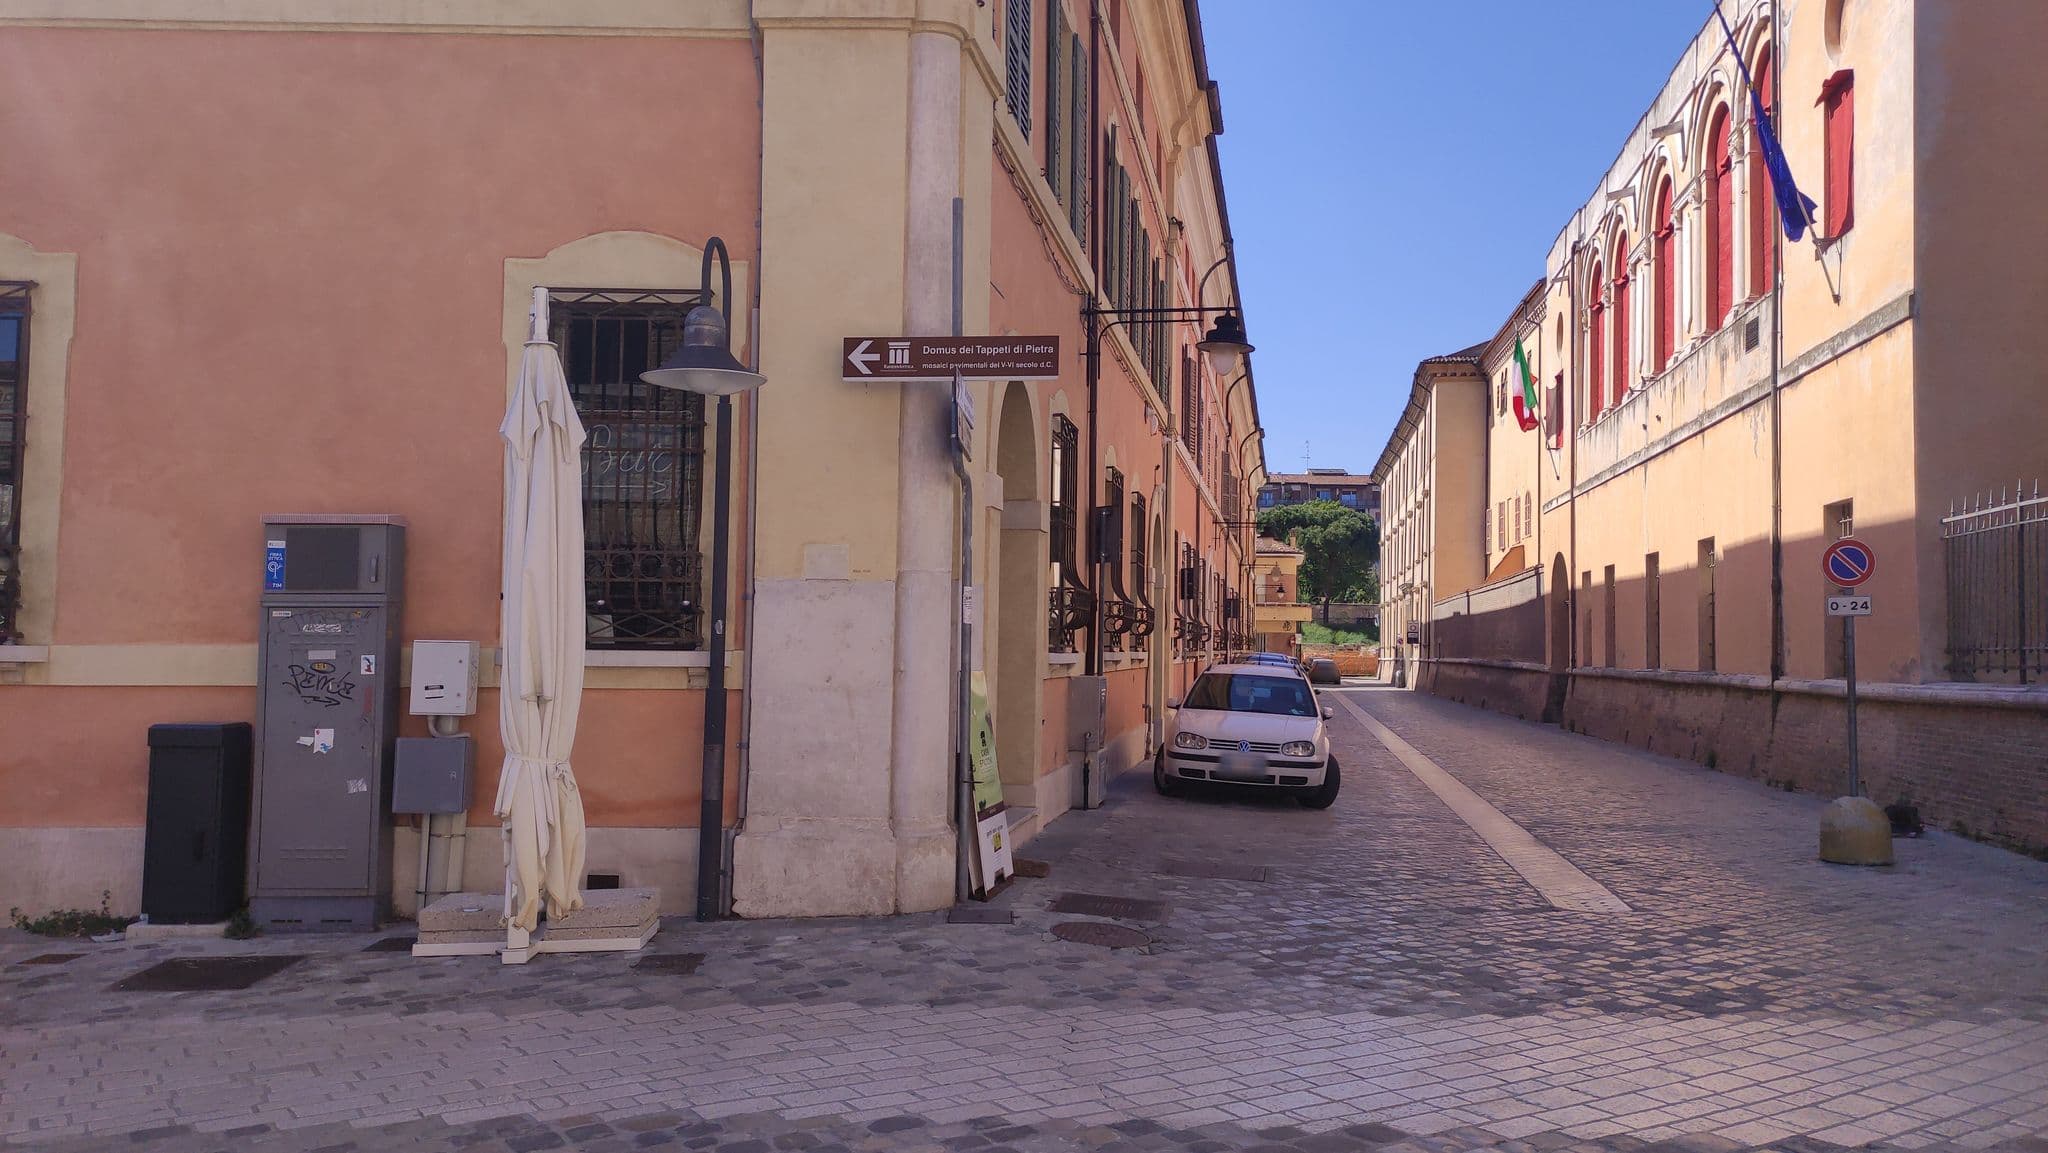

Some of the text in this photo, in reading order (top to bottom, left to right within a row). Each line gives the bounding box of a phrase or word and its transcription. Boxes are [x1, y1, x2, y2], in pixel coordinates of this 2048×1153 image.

[922, 344, 1054, 356] Domus dei Tappeti di Pietra
